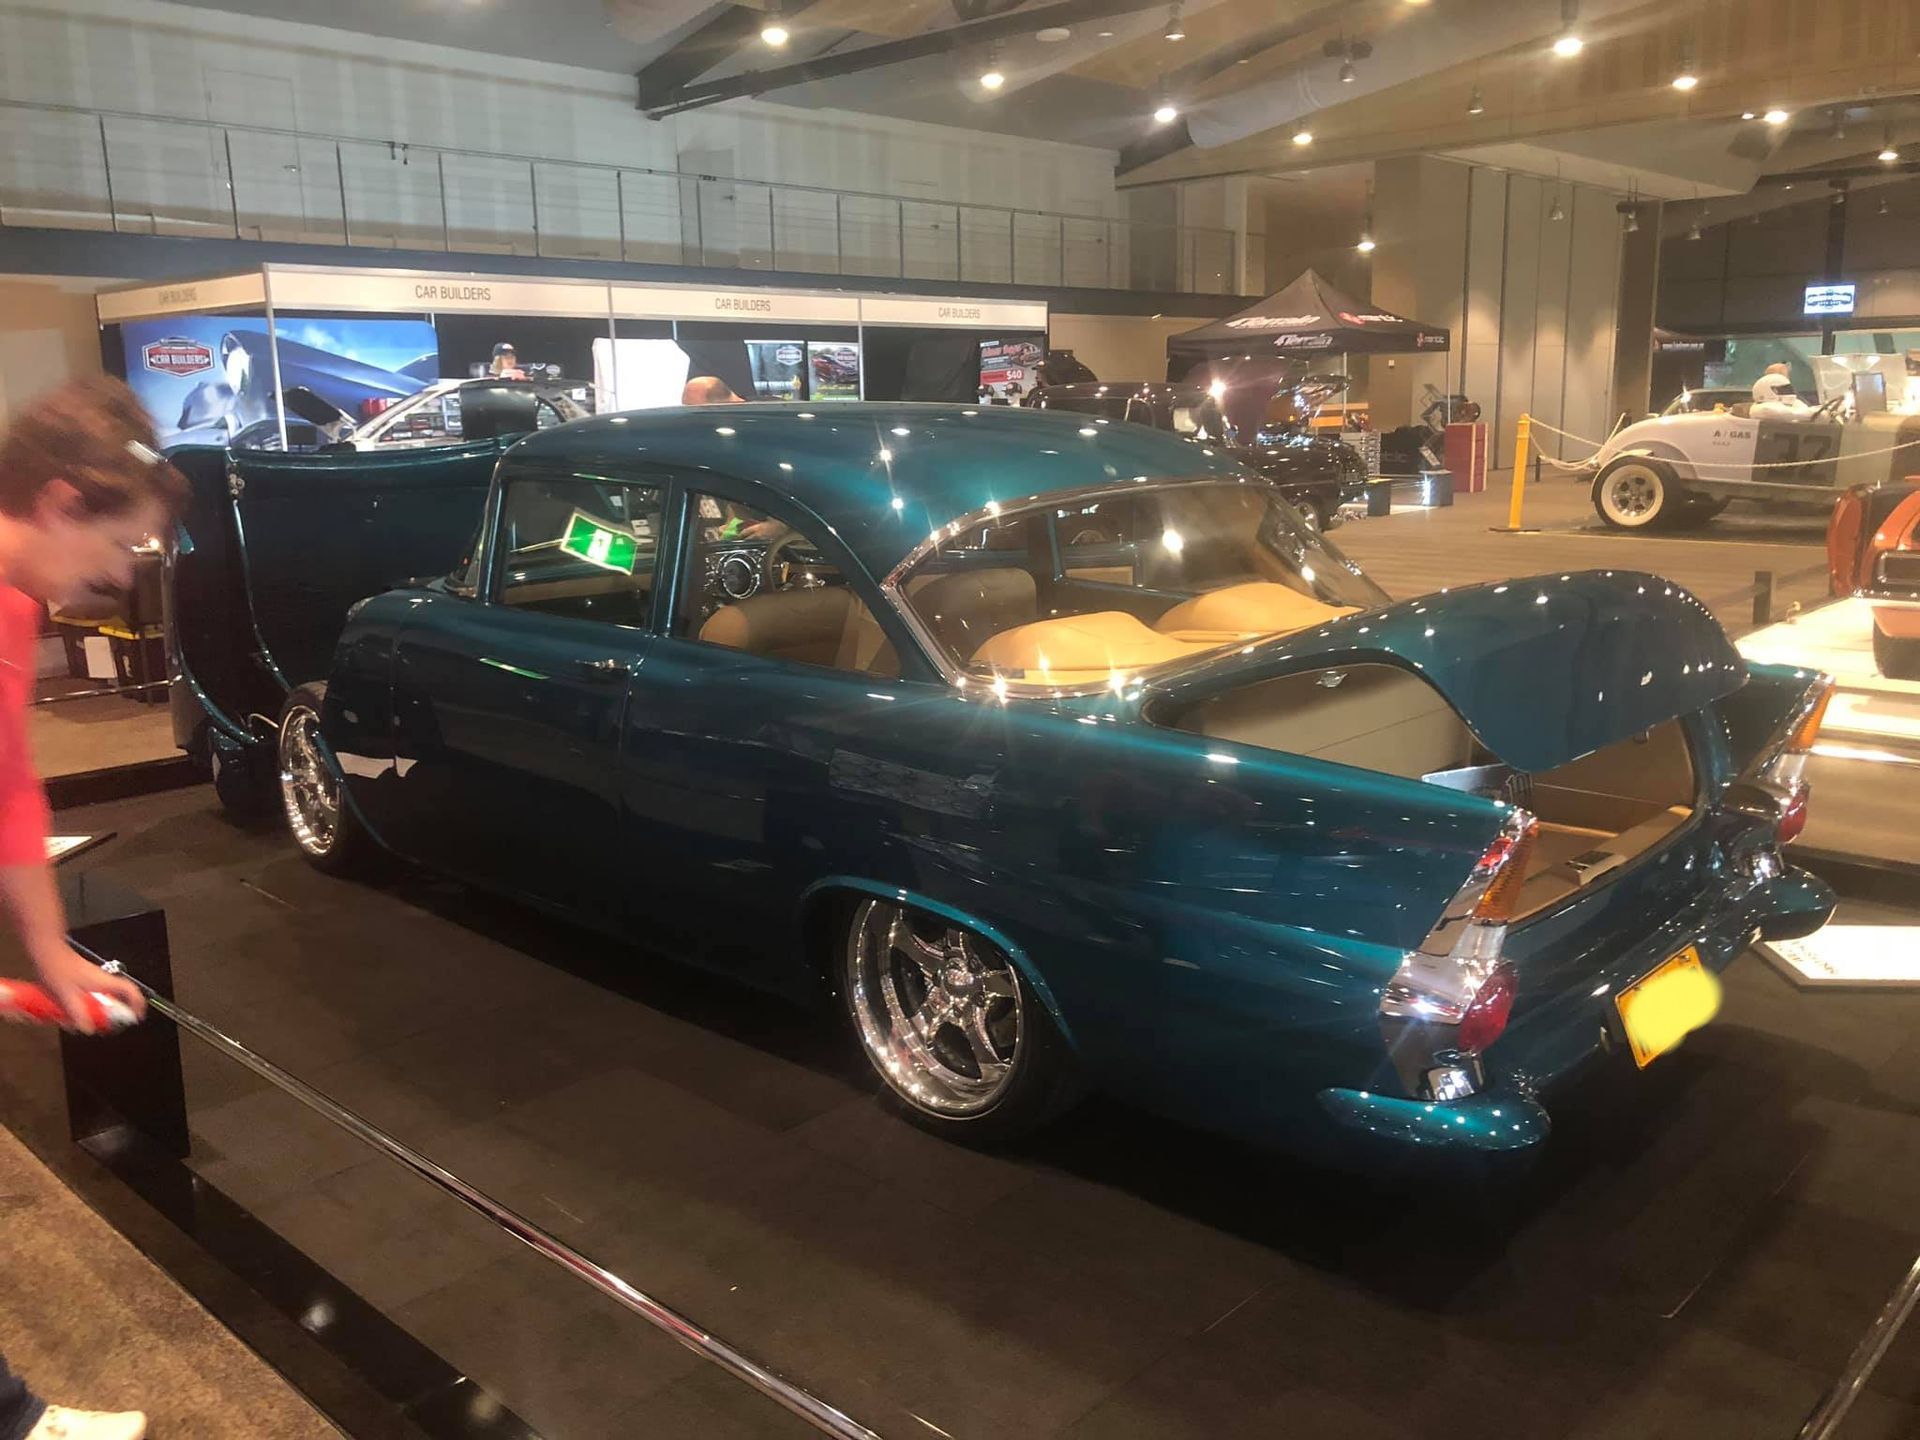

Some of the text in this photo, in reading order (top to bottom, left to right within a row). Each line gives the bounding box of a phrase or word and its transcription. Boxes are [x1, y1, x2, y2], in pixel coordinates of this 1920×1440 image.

[415, 285, 491, 301] CAR BUILDERS
[715, 298, 771, 312] CAR BUILDERS
[938, 306, 981, 319] CAR BUILDERS
